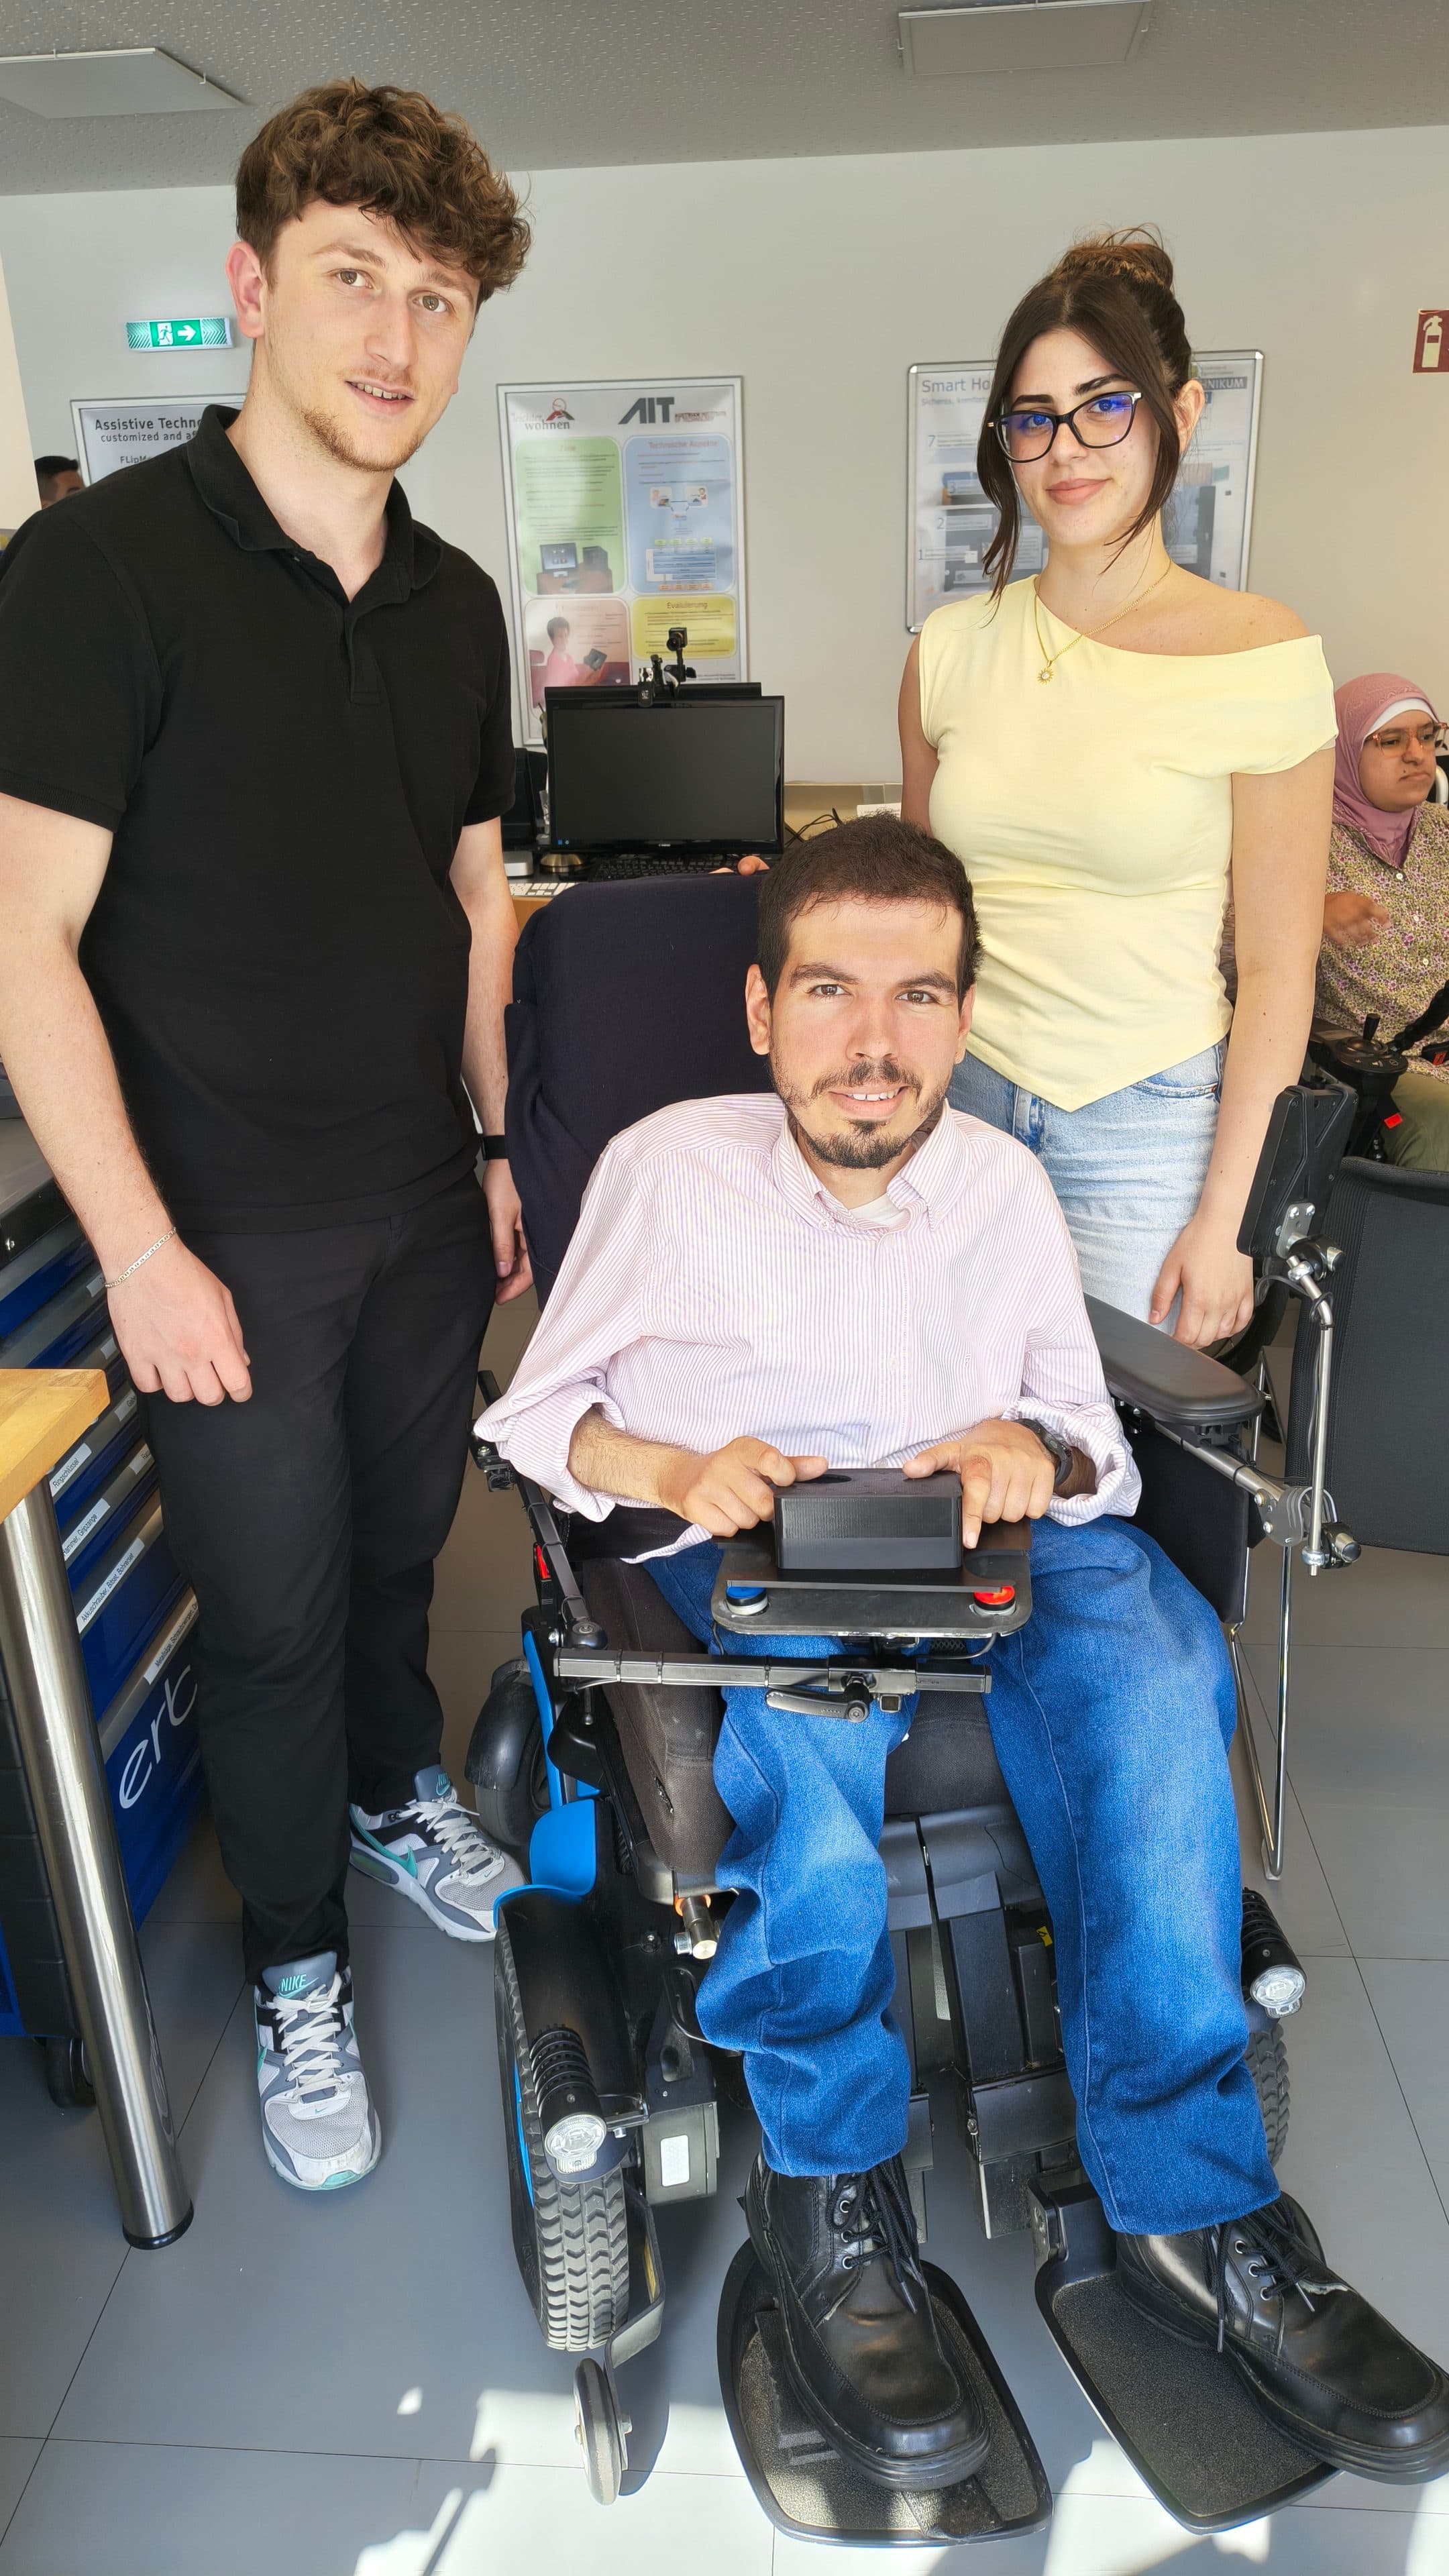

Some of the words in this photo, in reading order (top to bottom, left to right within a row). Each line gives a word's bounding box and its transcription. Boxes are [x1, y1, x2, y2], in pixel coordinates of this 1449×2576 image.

[922, 378, 966, 392] Smart
[618, 396, 674, 425] AIT
[95, 418, 154, 430] Assistive
[525, 419, 570, 430] wohnen
[101, 432, 159, 442] customized
[164, 431, 182, 441] and
[281, 1974, 307, 1992] NIKE
